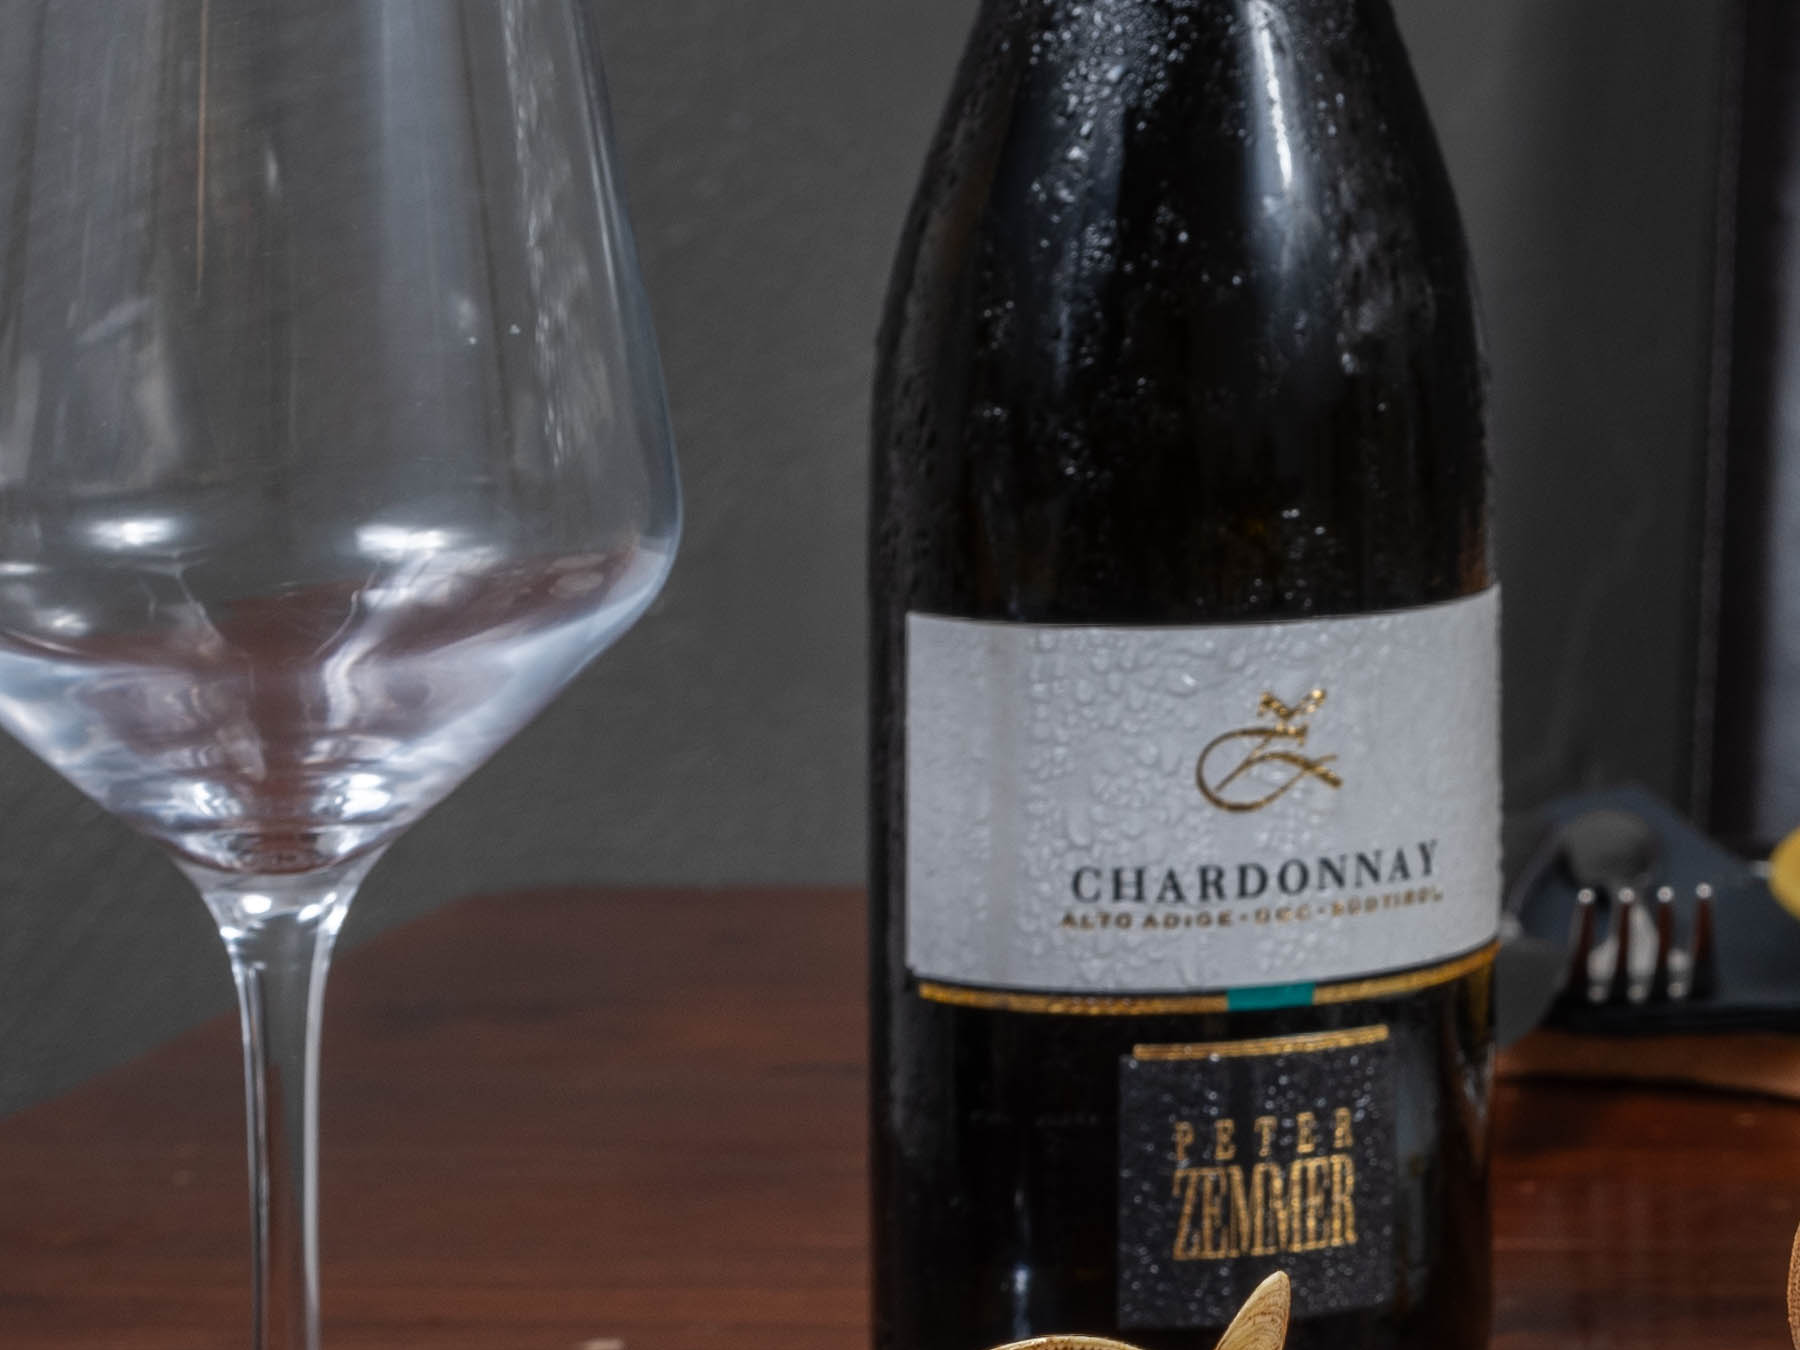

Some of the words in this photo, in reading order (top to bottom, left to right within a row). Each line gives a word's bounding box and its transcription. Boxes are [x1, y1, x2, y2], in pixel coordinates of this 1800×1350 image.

[1070, 838, 1439, 904] CHARDONNAY
[1060, 909, 1134, 931] ALTO
[1141, 909, 1234, 930] ADIGE
[1171, 1106, 1354, 1161] PETER
[1170, 1153, 1360, 1262] ZEMMER
